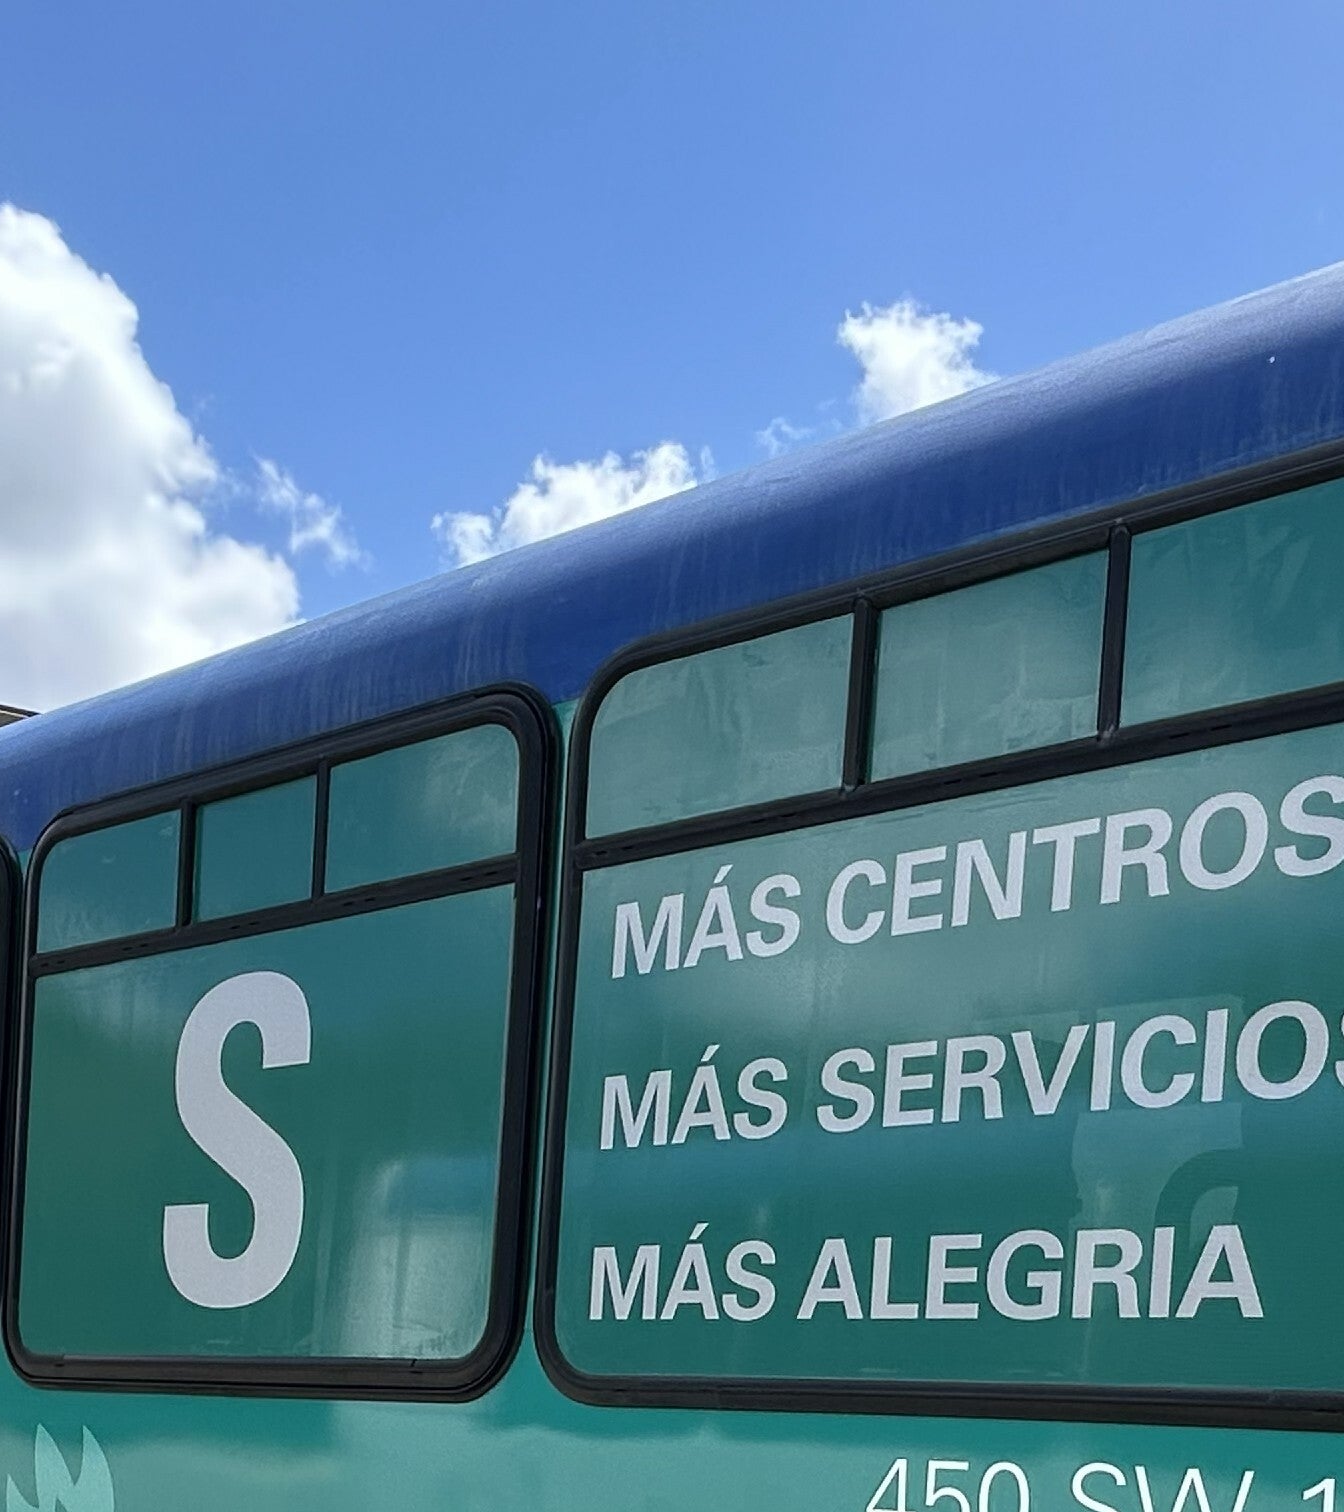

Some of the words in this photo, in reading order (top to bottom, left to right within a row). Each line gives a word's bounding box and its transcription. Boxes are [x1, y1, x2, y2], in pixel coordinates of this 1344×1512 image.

[611, 865, 801, 979] MÁS
[600, 1045, 787, 1150] MÁS
[589, 1223, 776, 1321] MÁS
[797, 1224, 1263, 1321] ALEGRIA
